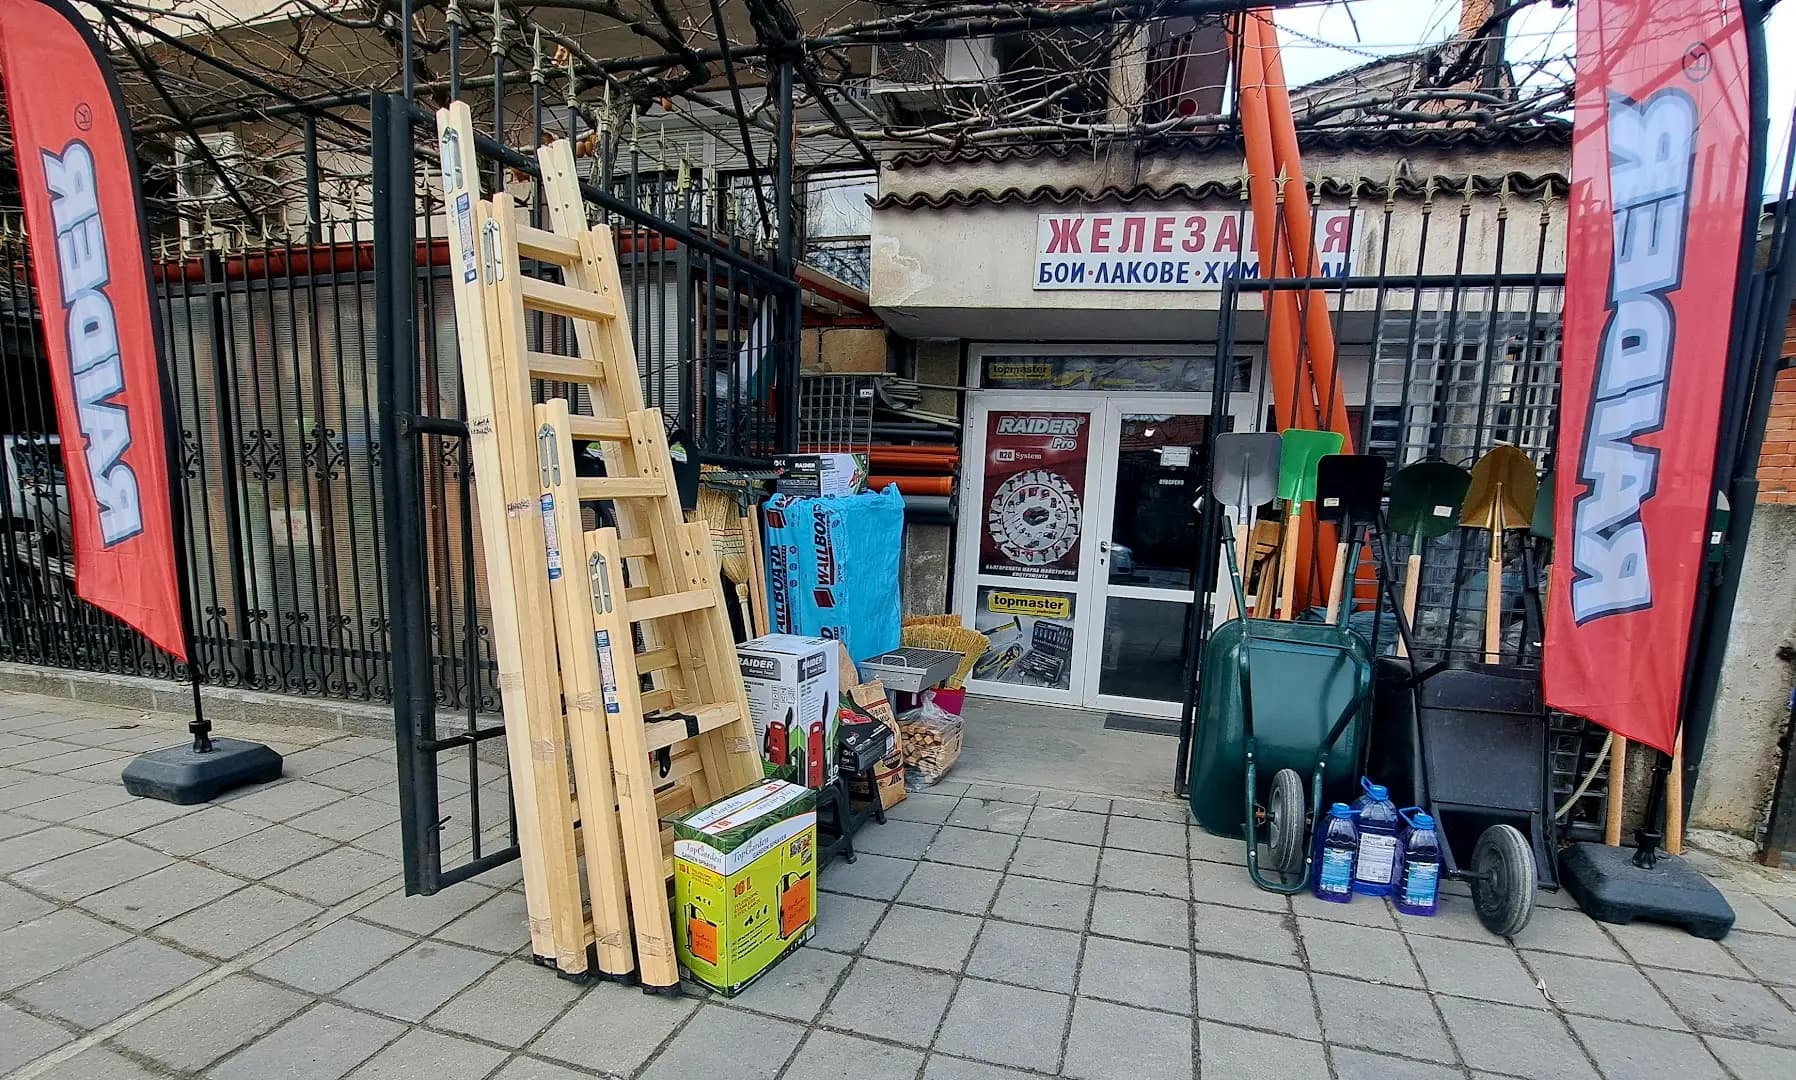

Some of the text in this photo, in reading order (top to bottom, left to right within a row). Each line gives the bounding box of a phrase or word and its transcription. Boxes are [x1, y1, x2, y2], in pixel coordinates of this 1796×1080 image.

[1045, 214, 1352, 254] ЖЕЛЕЗАЯ
[1038, 262, 1085, 284] БОИ
[1094, 262, 1189, 284] ЛАКОВЕ
[993, 364, 1047, 376] topmaster
[997, 416, 1077, 436] RAIDER
[1052, 436, 1076, 450] Pro
[1015, 451, 1042, 460] System
[770, 545, 786, 634] ALLBOARD
[994, 594, 1064, 610] topmaster
[732, 836, 769, 862] TopGarden
